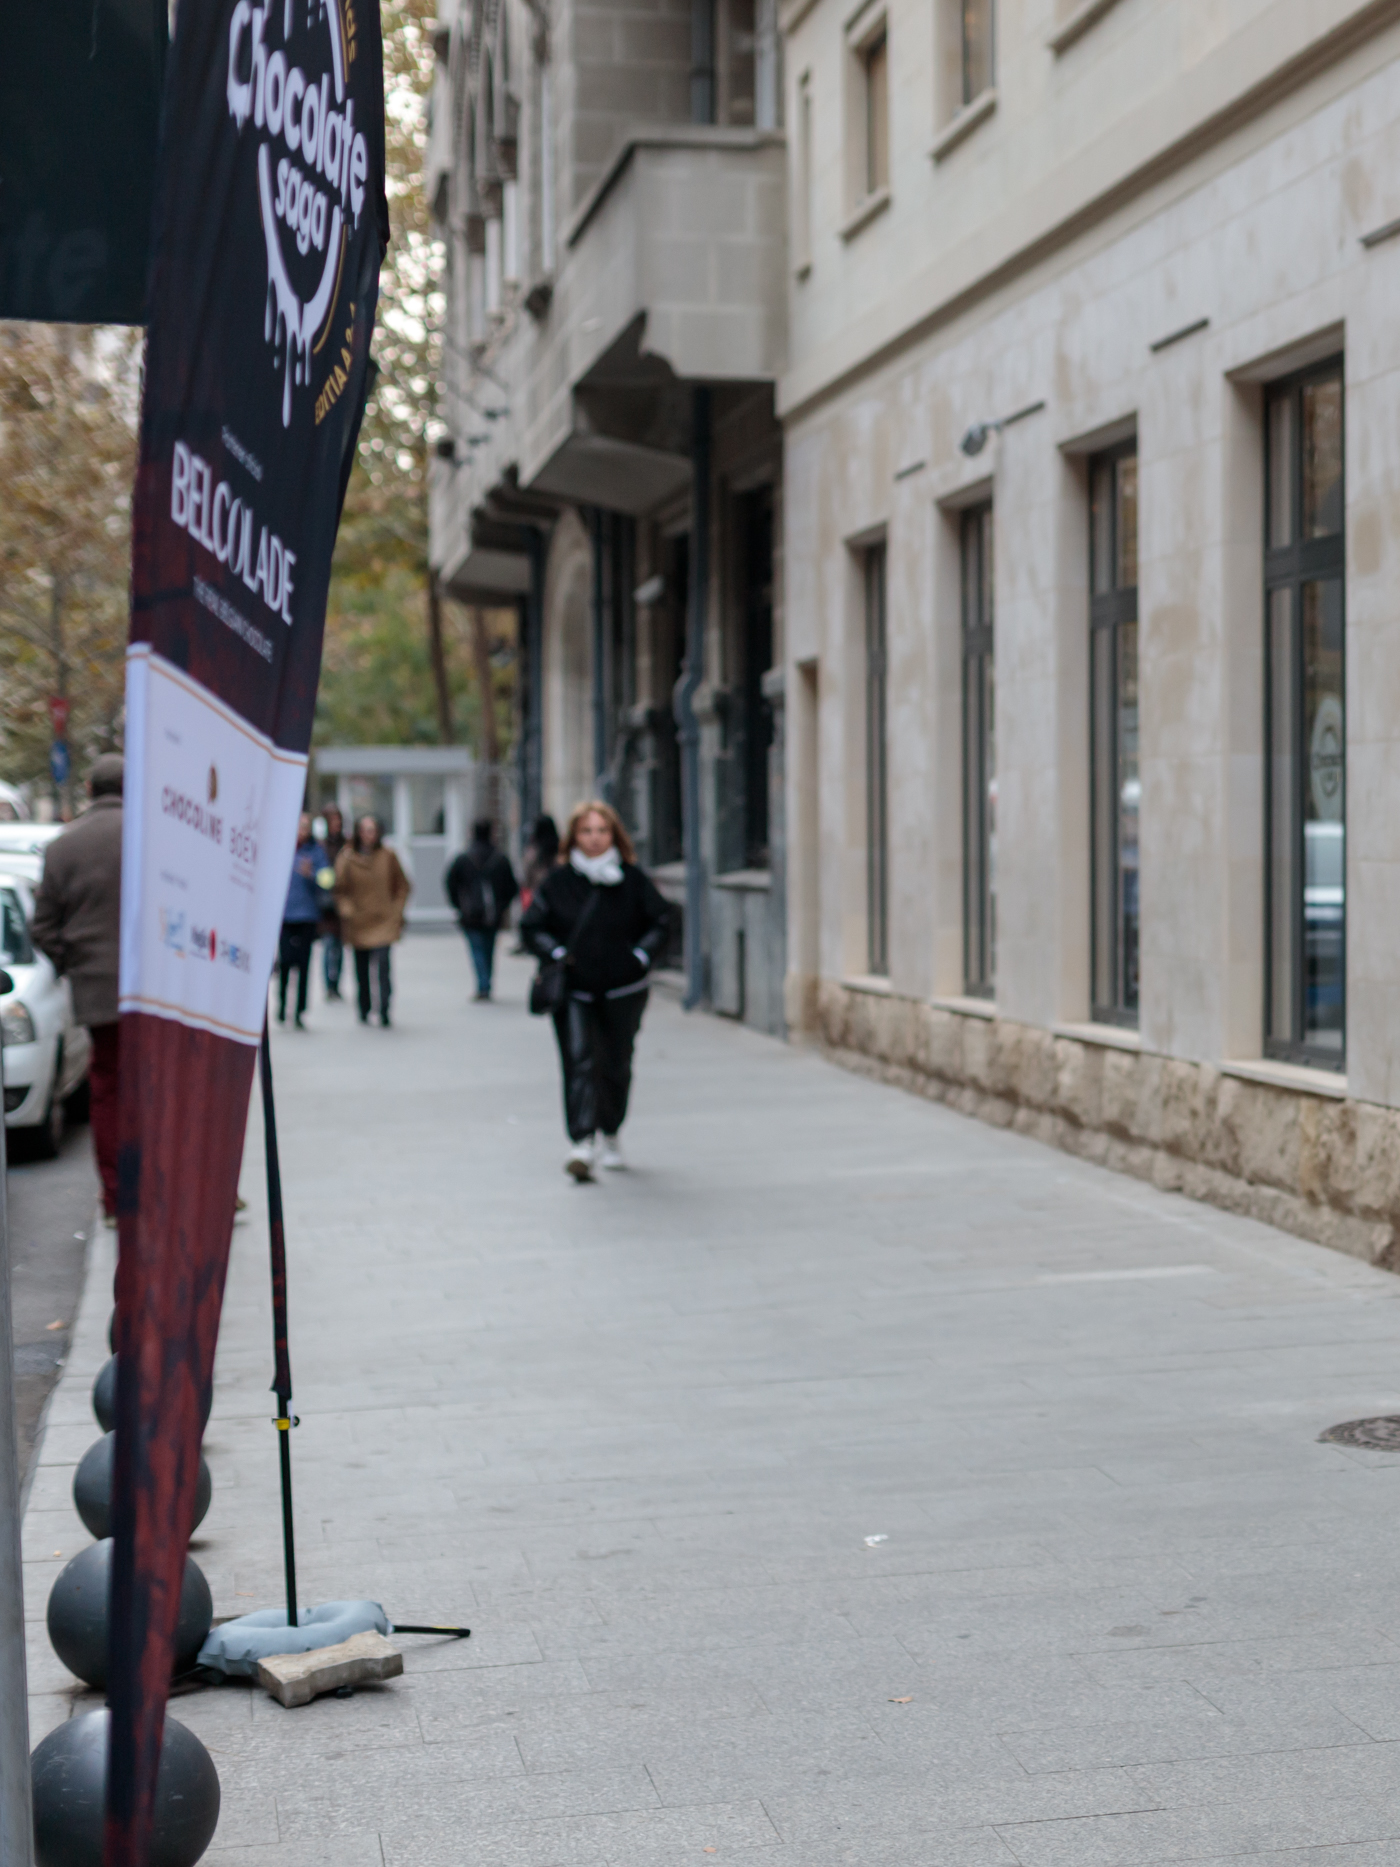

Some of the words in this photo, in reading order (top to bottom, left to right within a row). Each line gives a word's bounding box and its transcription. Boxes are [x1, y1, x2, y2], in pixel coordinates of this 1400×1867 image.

[227, 0, 368, 230] Chocolate
[275, 157, 328, 256] saga
[170, 440, 297, 626] BELCOLADE
